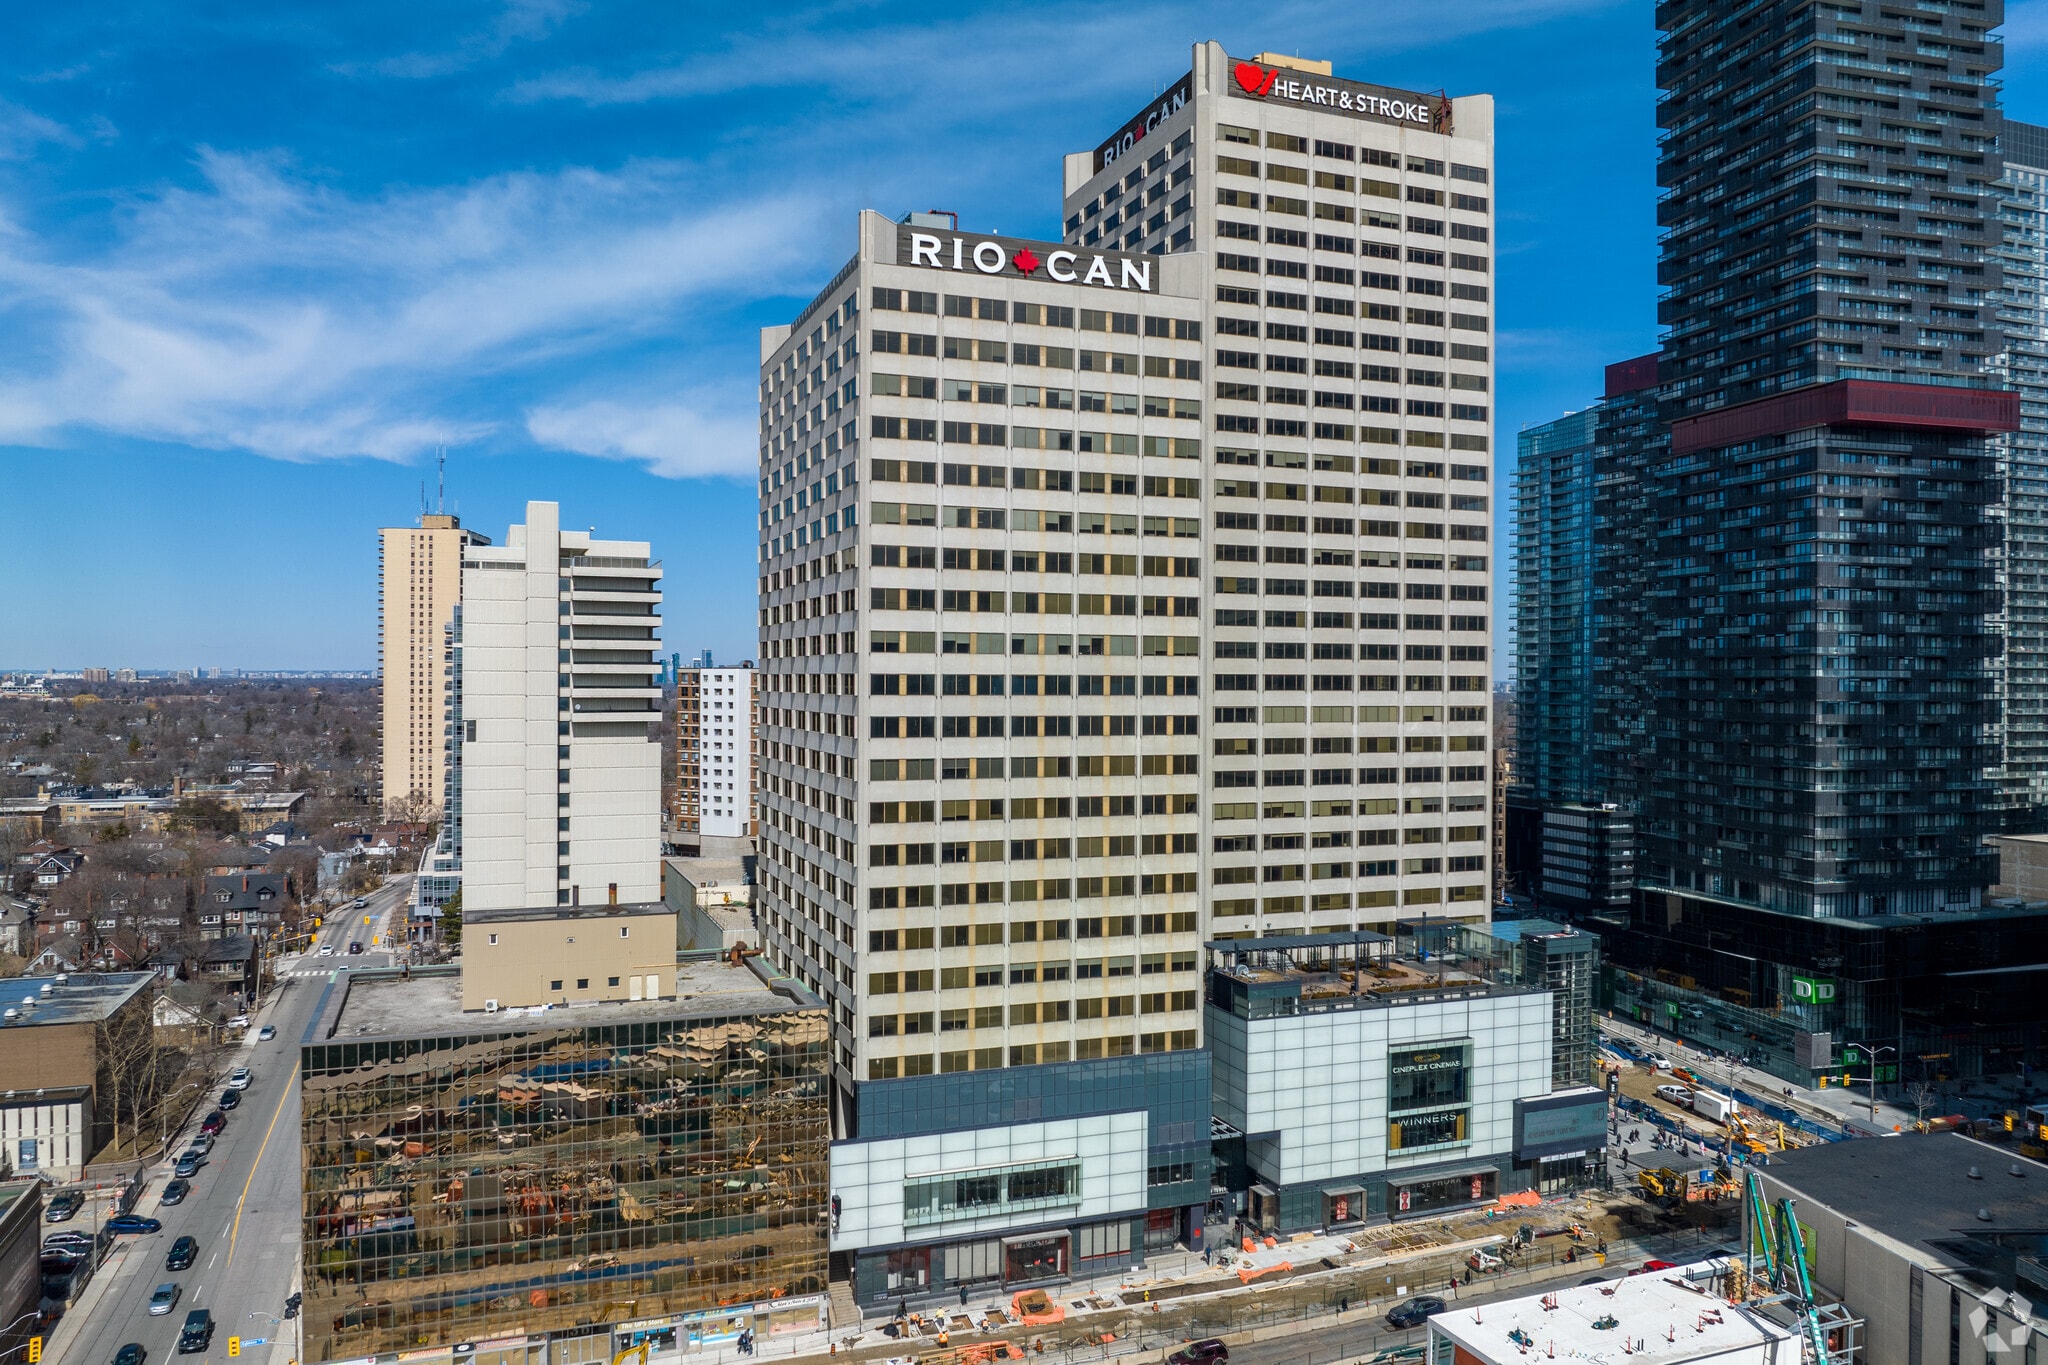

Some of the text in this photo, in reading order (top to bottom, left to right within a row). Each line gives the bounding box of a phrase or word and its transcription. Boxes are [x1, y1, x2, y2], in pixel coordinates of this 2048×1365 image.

[1274, 78, 1339, 107] HEART
[1356, 95, 1429, 124] STROKE
[1103, 87, 1186, 168] RIO CAN
[910, 232, 1151, 291] RIO CAN
[1793, 979, 1812, 997] TD
[1816, 983, 1835, 999] TD
[1392, 1060, 1461, 1074] CINEPLEX CINEMAS
[1398, 1111, 1457, 1127] WINNERS
